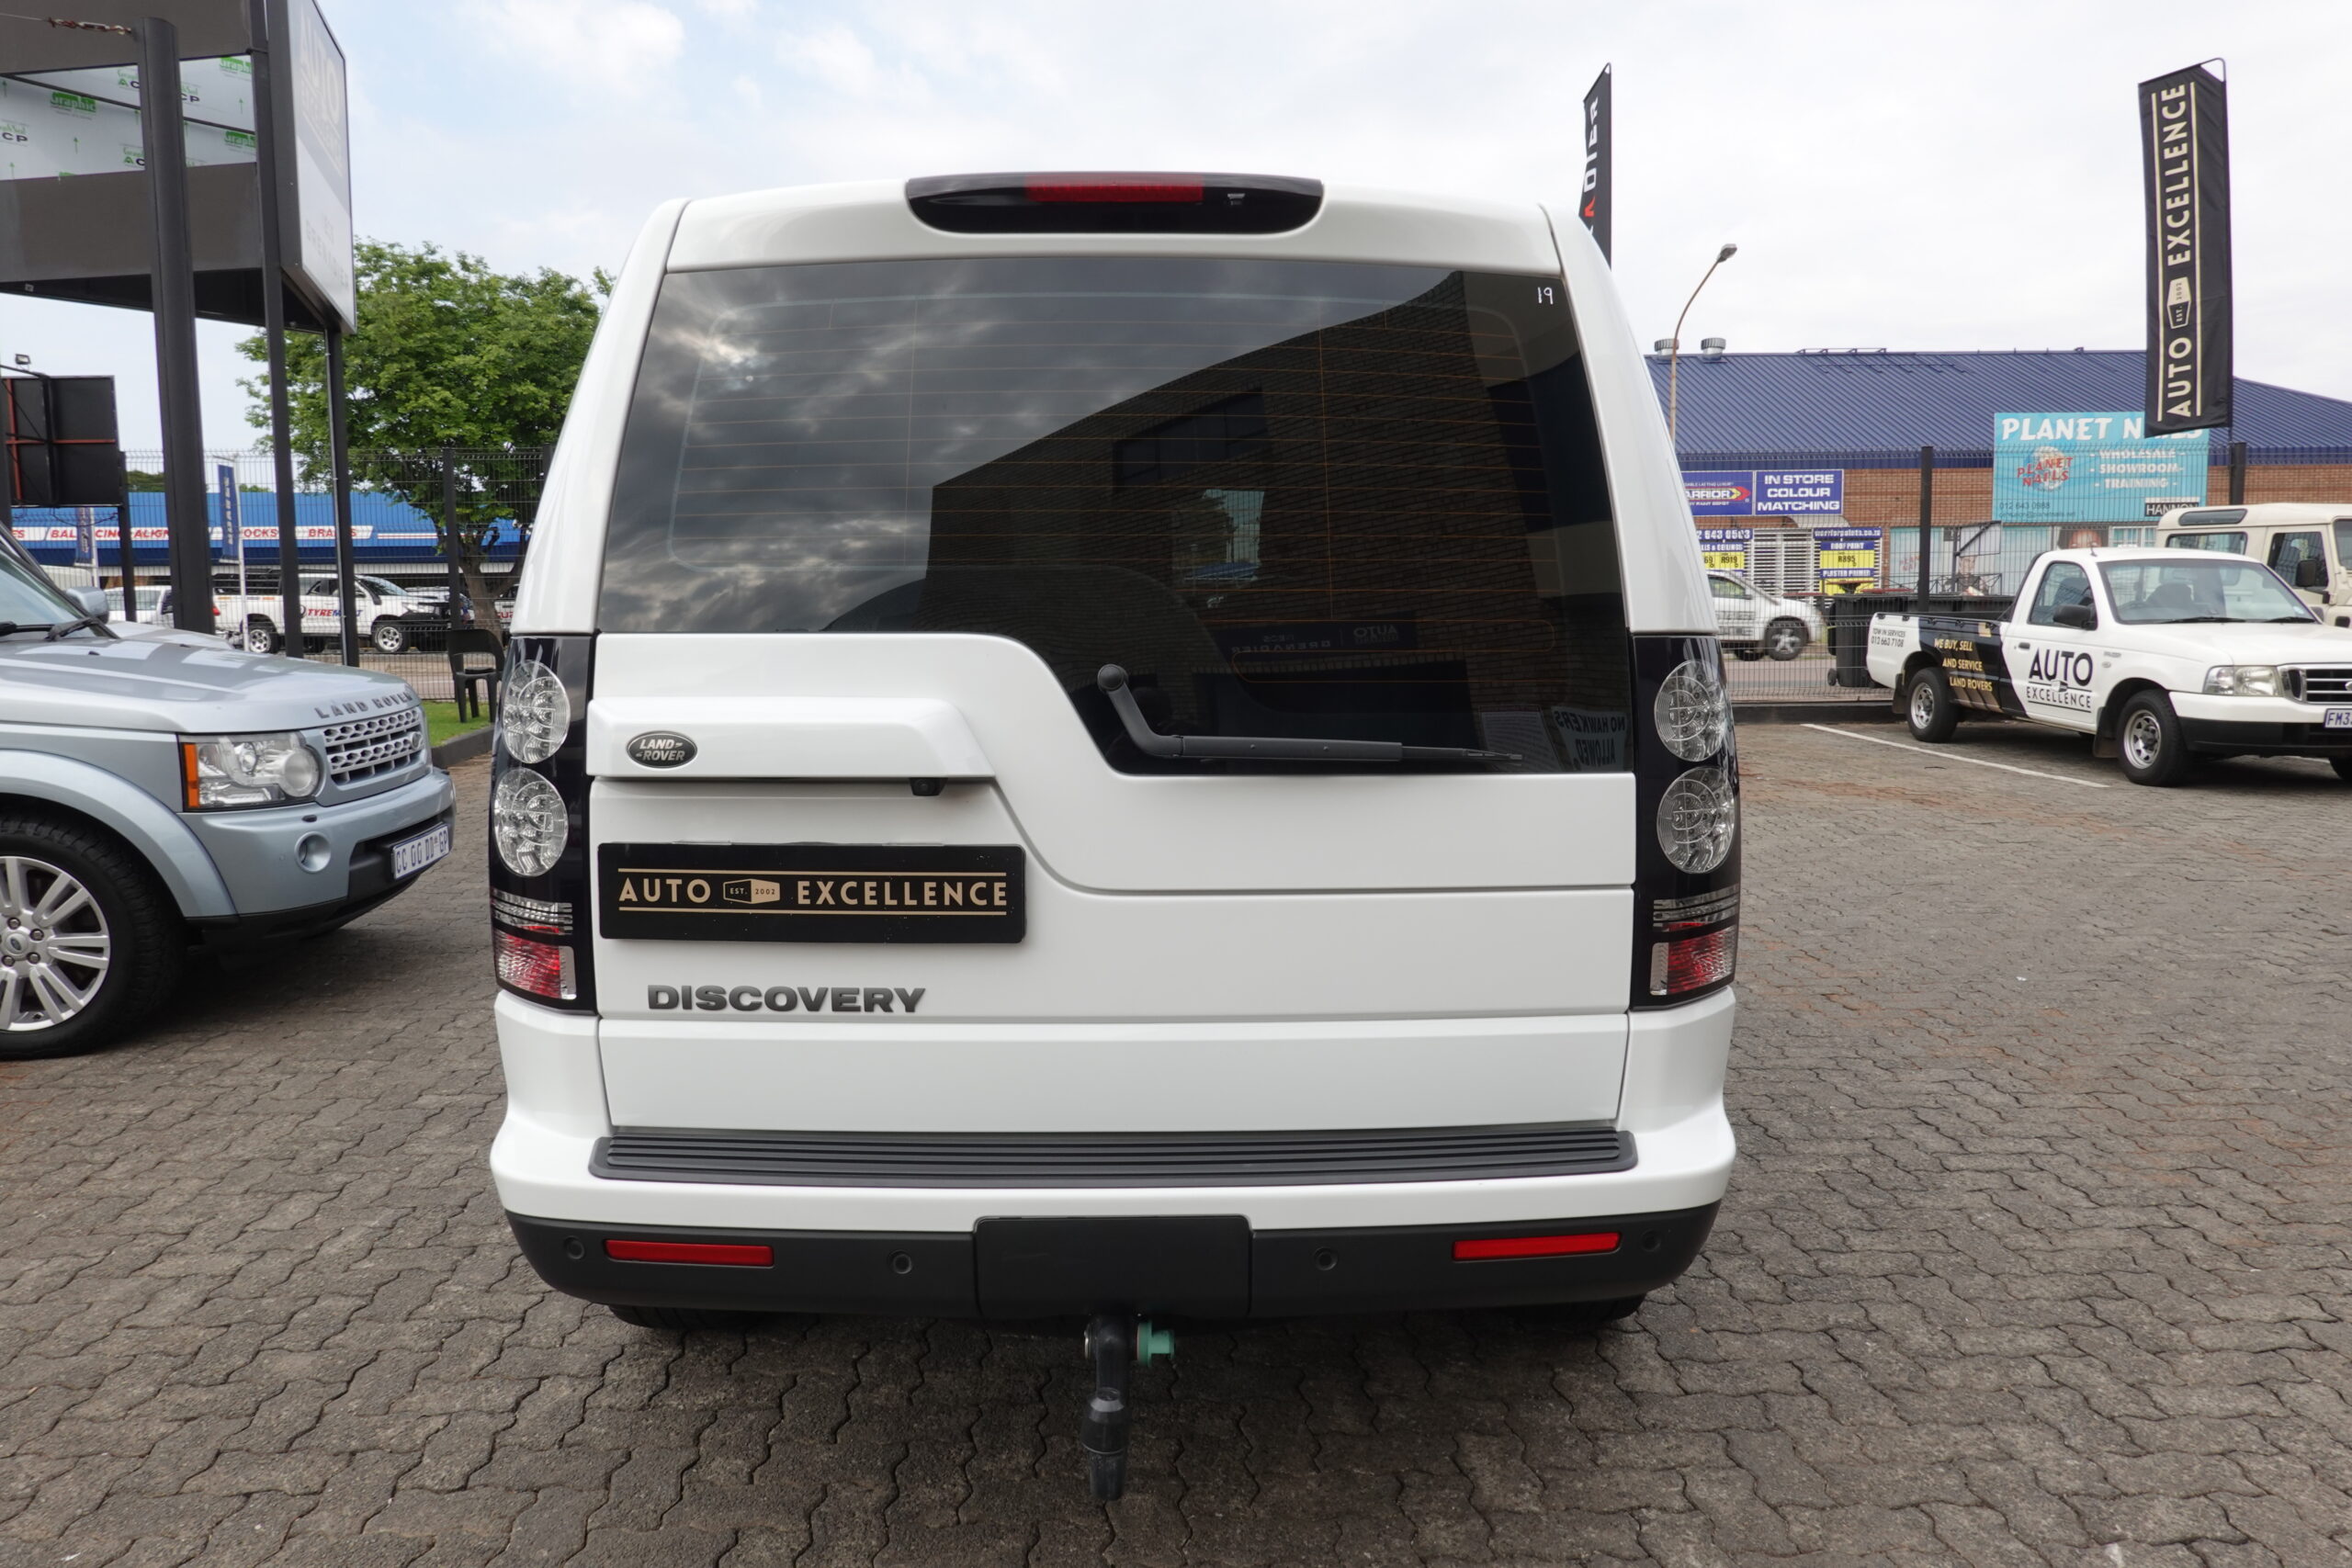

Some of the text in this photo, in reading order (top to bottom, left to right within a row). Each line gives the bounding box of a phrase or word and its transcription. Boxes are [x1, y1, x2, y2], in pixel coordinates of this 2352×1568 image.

[2, 131, 28, 142] CP
[2161, 84, 2190, 266] EXCELLENCE
[1537, 287, 1554, 305] 19
[2166, 337, 2192, 417] AUTO
[2002, 417, 2112, 441] PLANET
[2099, 449, 2176, 458] WHOLESALE
[2017, 457, 2073, 478] PLANET
[1764, 474, 1835, 484] IN STORE
[2022, 469, 2069, 487] NAILS
[2104, 478, 2169, 488] TRAINING
[1685, 490, 1731, 499] ARRIOR
[1767, 487, 1831, 498] COLOUR
[1757, 501, 1840, 511] MATCHING
[243, 528, 278, 538] OCKS
[1934, 638, 1943, 648] WE
[1959, 640, 1973, 651] SELL
[1941, 658, 1983, 671] AND SERVICE
[2028, 648, 2094, 687] AUTO
[1950, 676, 1993, 692] LAND ROVERS
[2026, 686, 2092, 708] EXCELLENCE
[314, 691, 413, 719] LAND ROVER
[2327, 712, 2352, 726] FM3
[639, 739, 675, 750] LAND
[641, 750, 685, 761] ROVER
[396, 847, 408, 874] CC
[438, 829, 447, 853] GP
[618, 877, 711, 904] AUTO
[797, 880, 1008, 907] EXCELLENCE
[647, 984, 926, 1014] DISCOVERY
